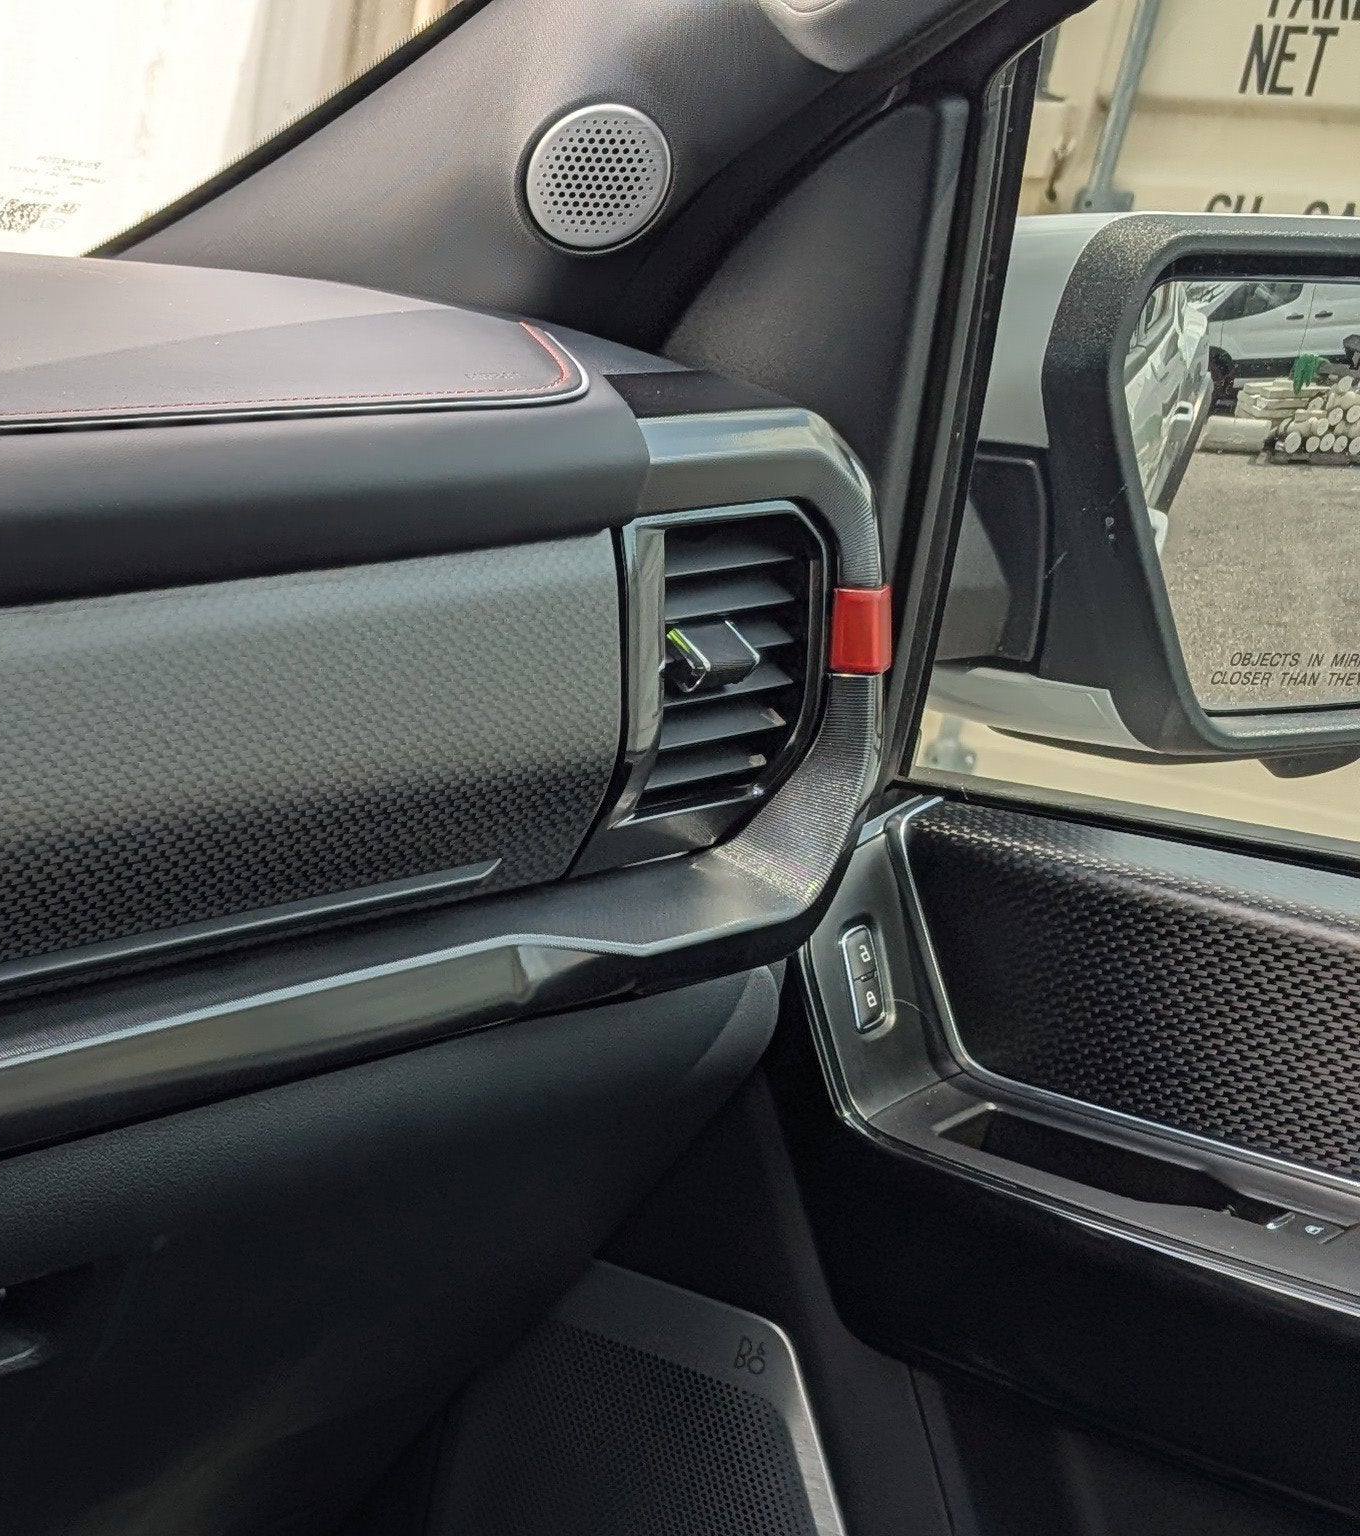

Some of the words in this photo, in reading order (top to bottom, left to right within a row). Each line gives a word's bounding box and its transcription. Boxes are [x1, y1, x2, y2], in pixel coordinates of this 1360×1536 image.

[1238, 24, 1340, 97] NET
[1230, 652, 1300, 667] OBJECTS
[1307, 653, 1325, 667] IN
[1210, 671, 1272, 686] CLOSER
[1280, 672, 1321, 687] THAN
